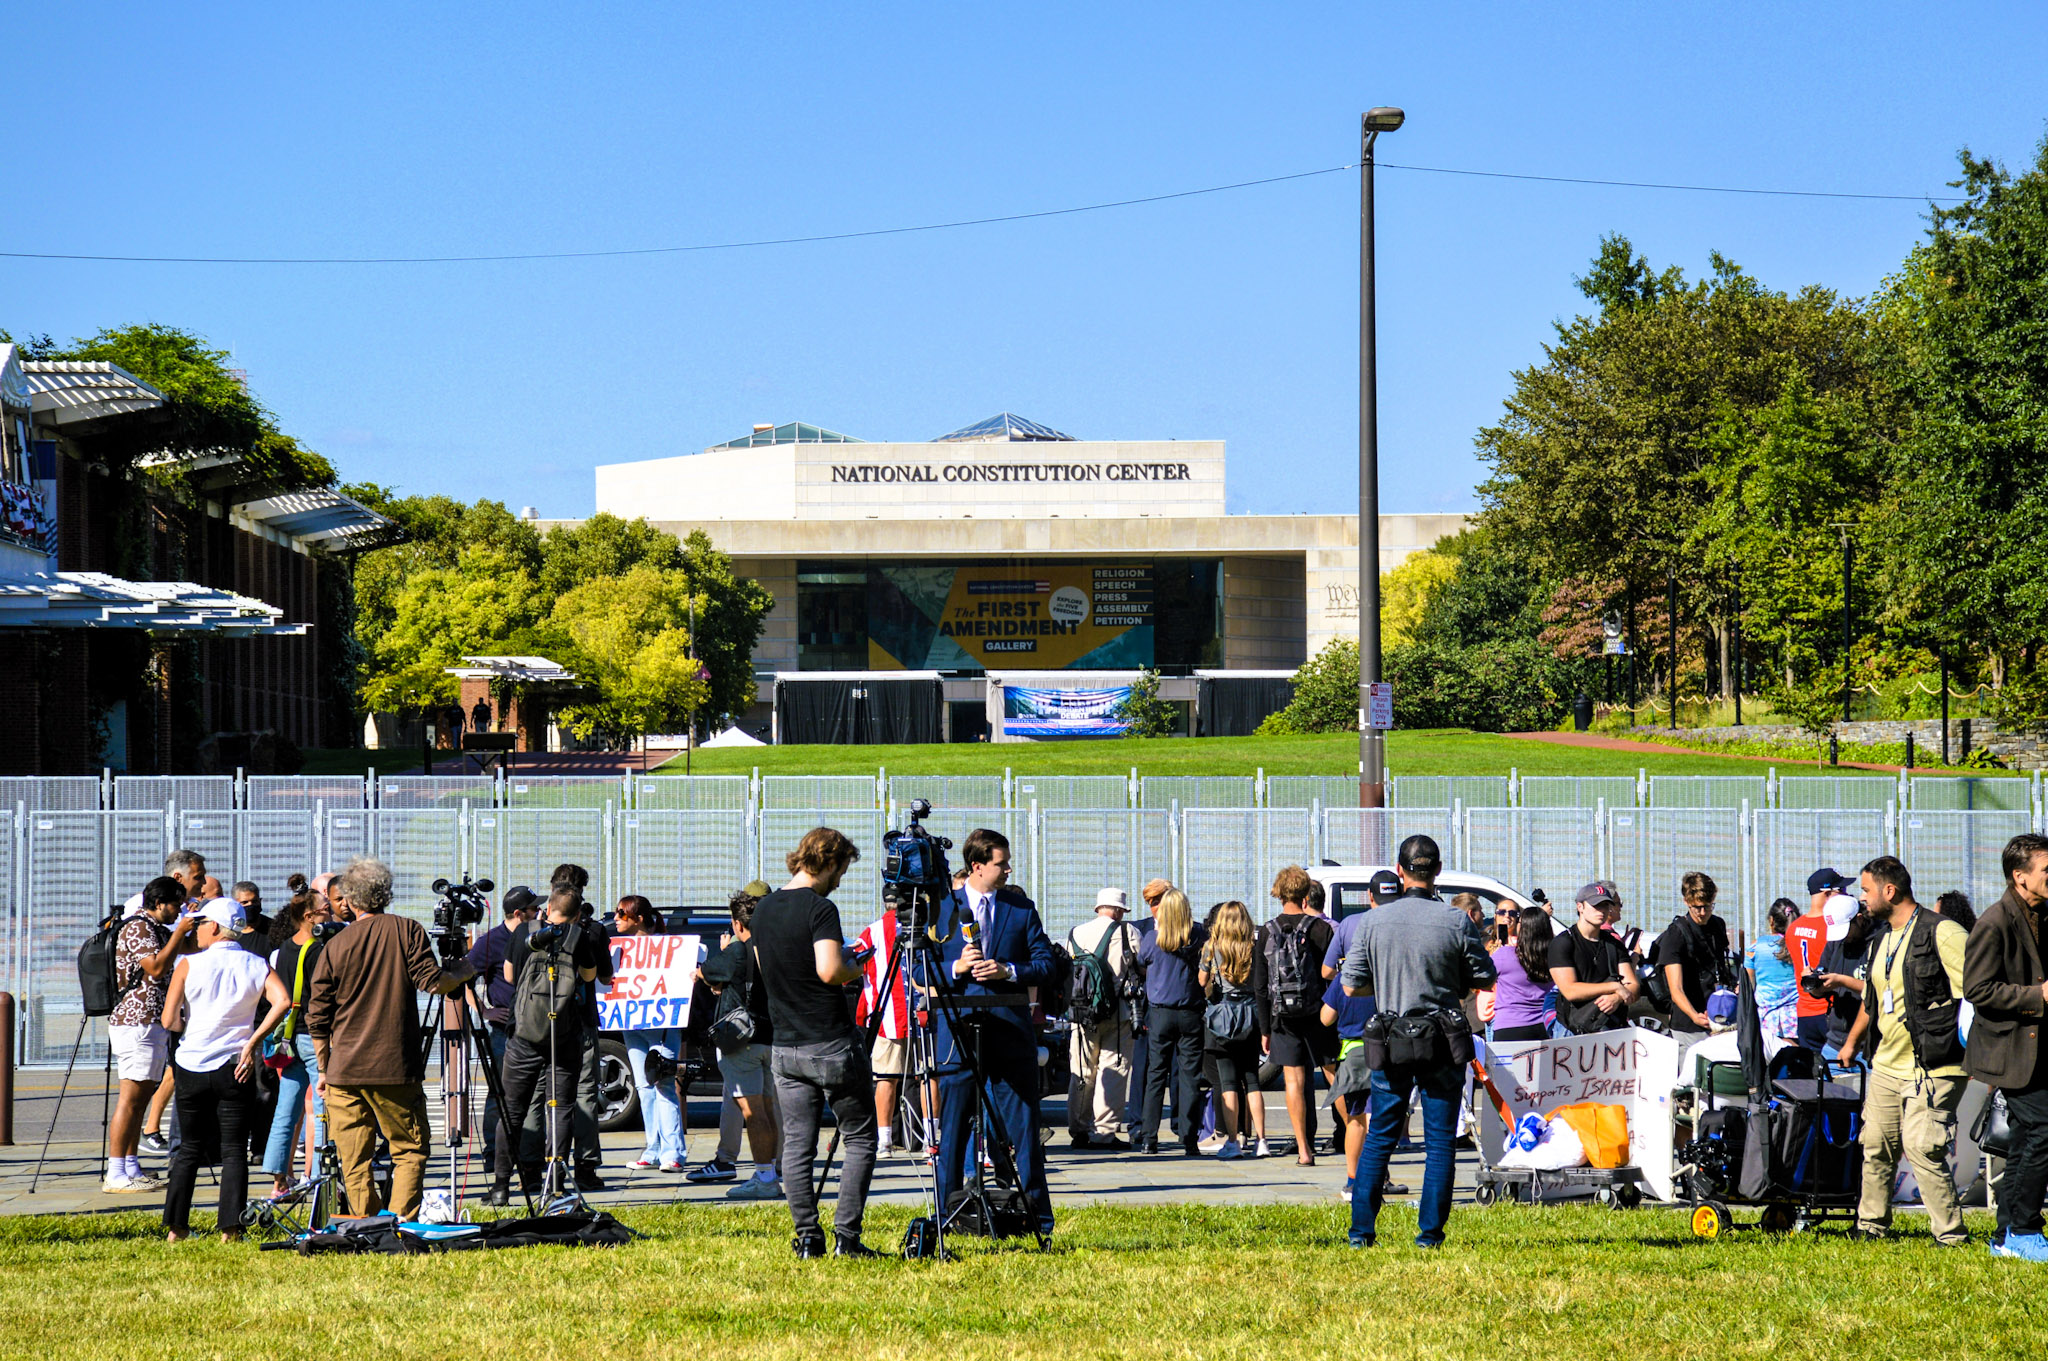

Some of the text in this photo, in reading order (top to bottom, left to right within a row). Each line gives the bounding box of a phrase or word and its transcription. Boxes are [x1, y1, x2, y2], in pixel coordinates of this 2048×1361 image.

[831, 464, 1191, 482] NATIONAL CONSTITUTION CENTER
[1094, 569, 1145, 578] RELIGION
[1094, 581, 1136, 590] SPEECH
[1057, 596, 1083, 605] EXPLORE
[1094, 593, 1128, 601] PRESS
[954, 602, 1040, 618] The FIRST
[1052, 607, 1084, 616] FREEDOMS
[1095, 604, 1149, 613] ASSEMBLY
[1095, 616, 1143, 625] PETITION
[939, 619, 1080, 637] AMENDMENT
[986, 641, 1034, 651] GALLERY
[1800, 939, 1810, 968] 1
[604, 974, 668, 1001] IS A
[1512, 1039, 1648, 1082] TRUMP
[1575, 1075, 1648, 1101] ISRAEL
